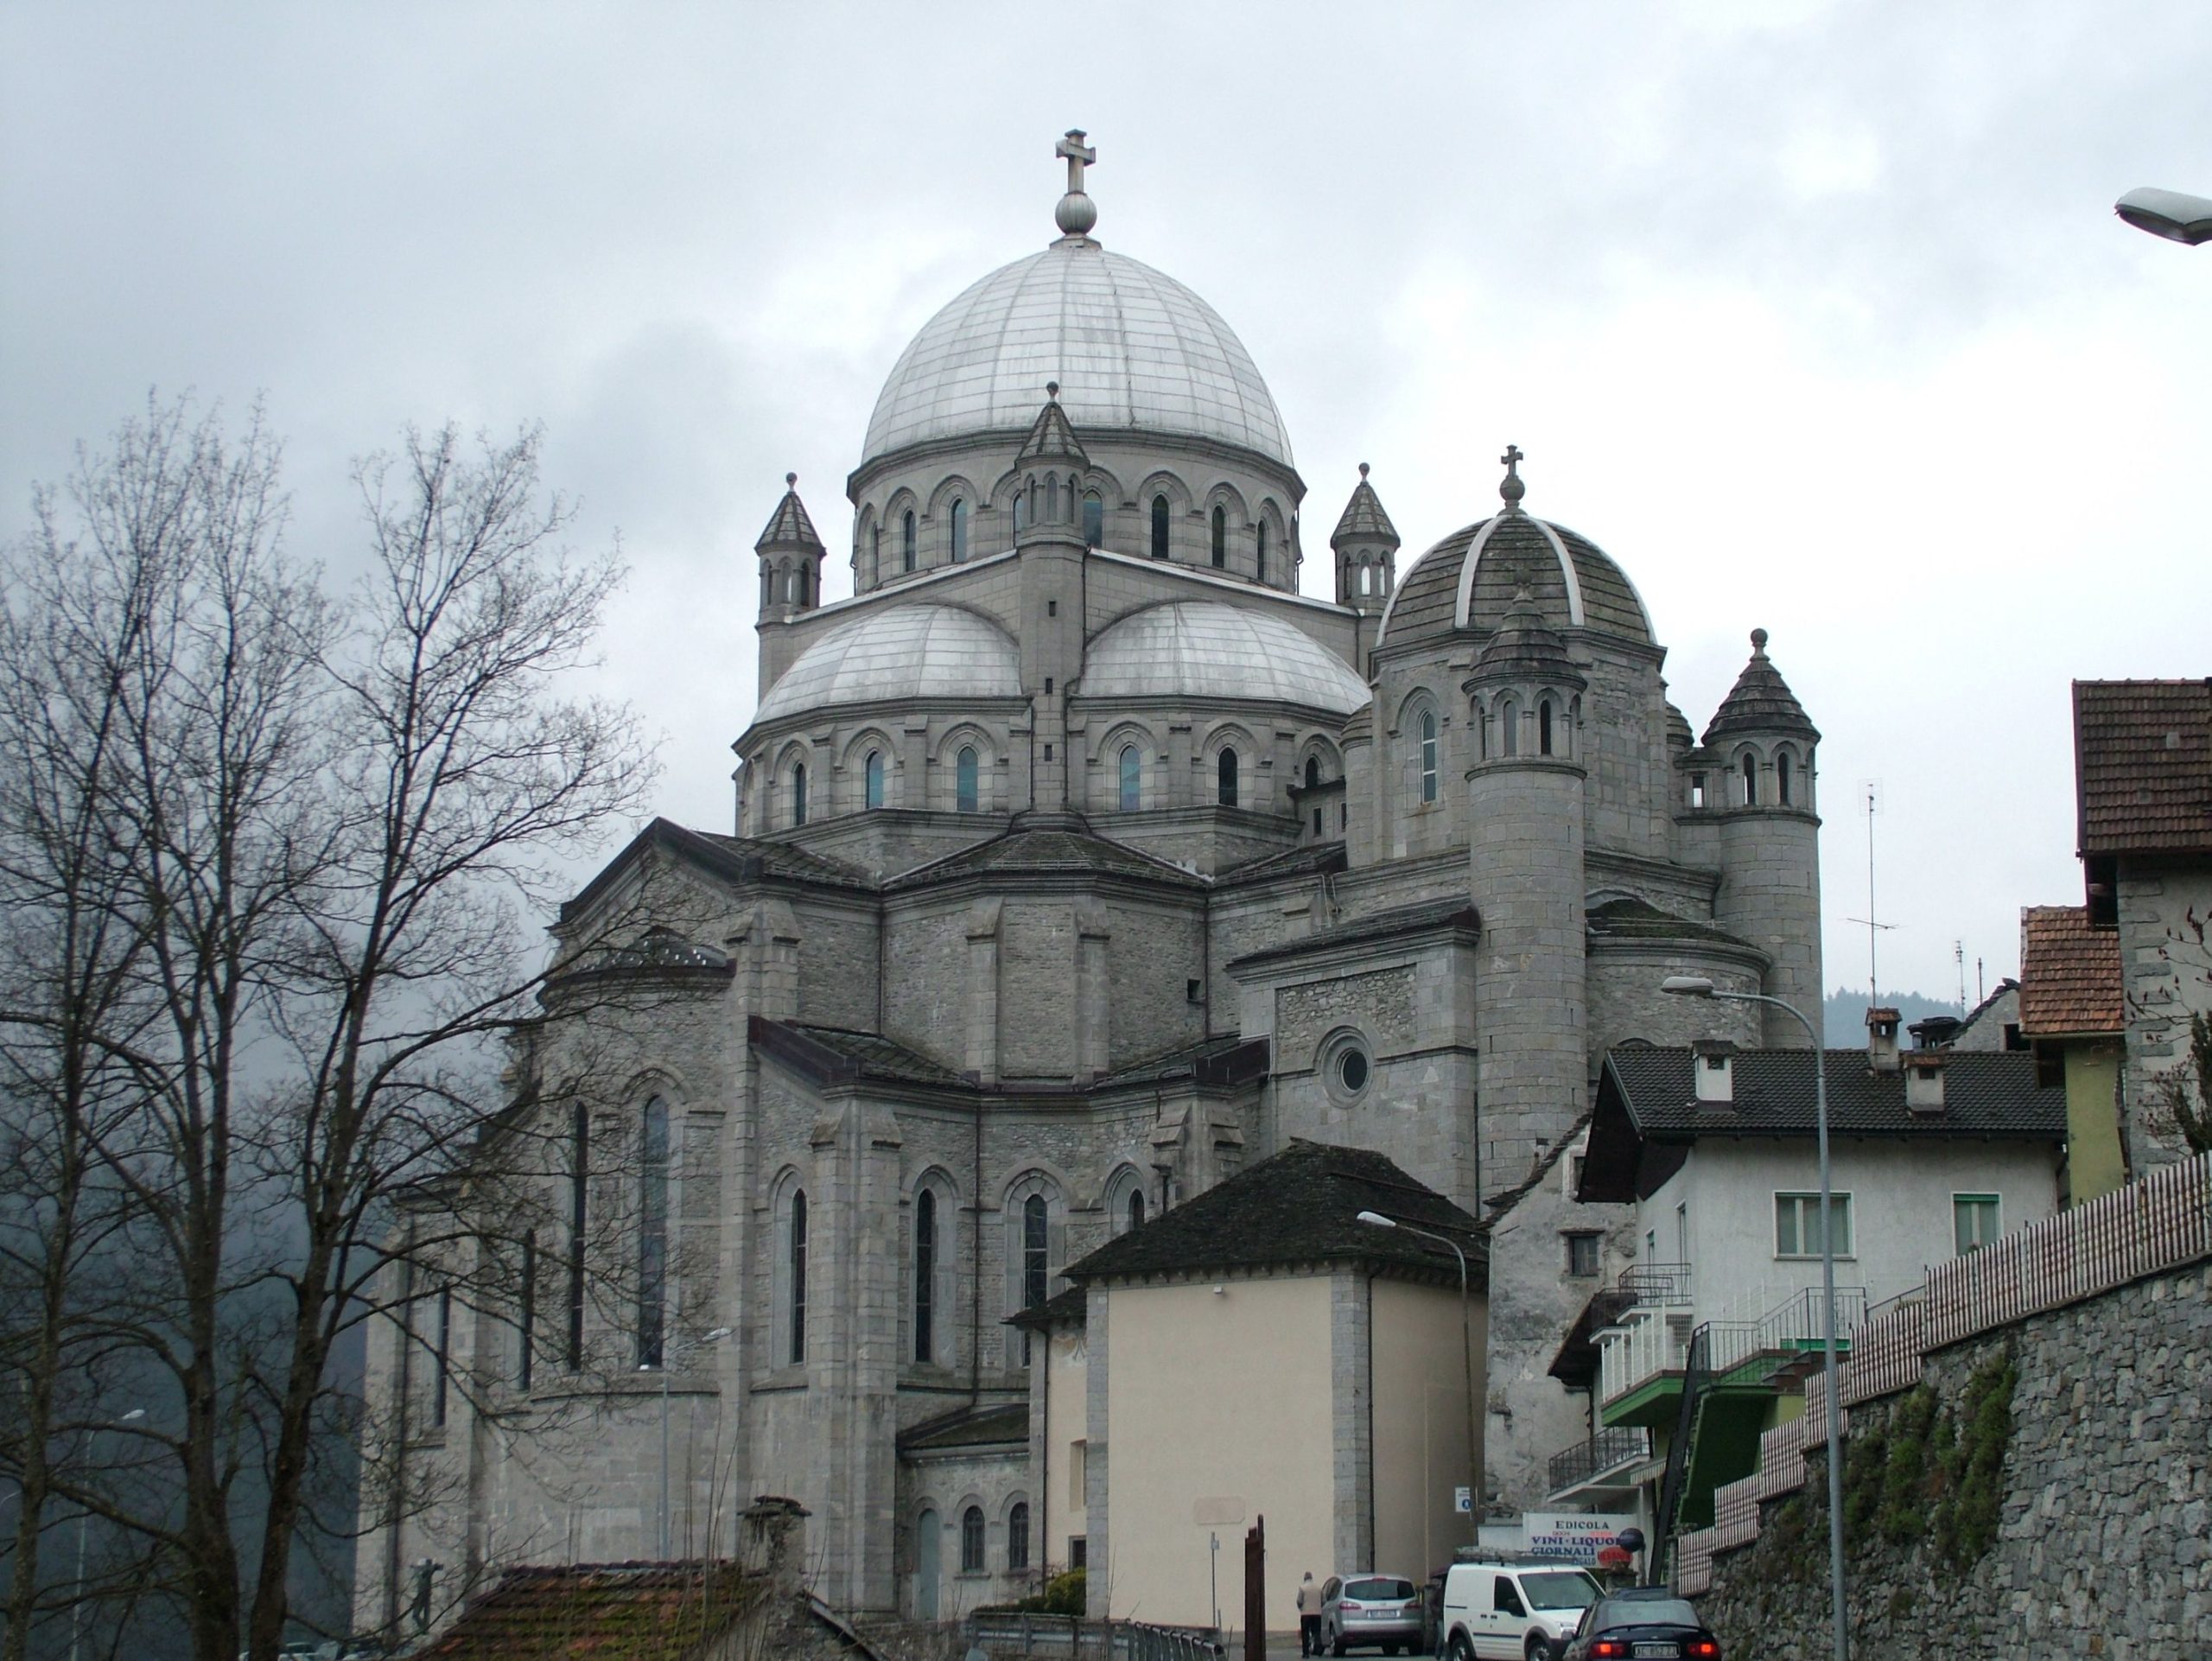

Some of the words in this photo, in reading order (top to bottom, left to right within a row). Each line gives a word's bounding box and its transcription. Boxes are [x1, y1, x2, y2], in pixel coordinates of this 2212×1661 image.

[1555, 1520, 1610, 1530] EDICOLA
[1532, 1537, 1563, 1545] VINI
[1531, 1546, 1595, 1556] GIORNALI
